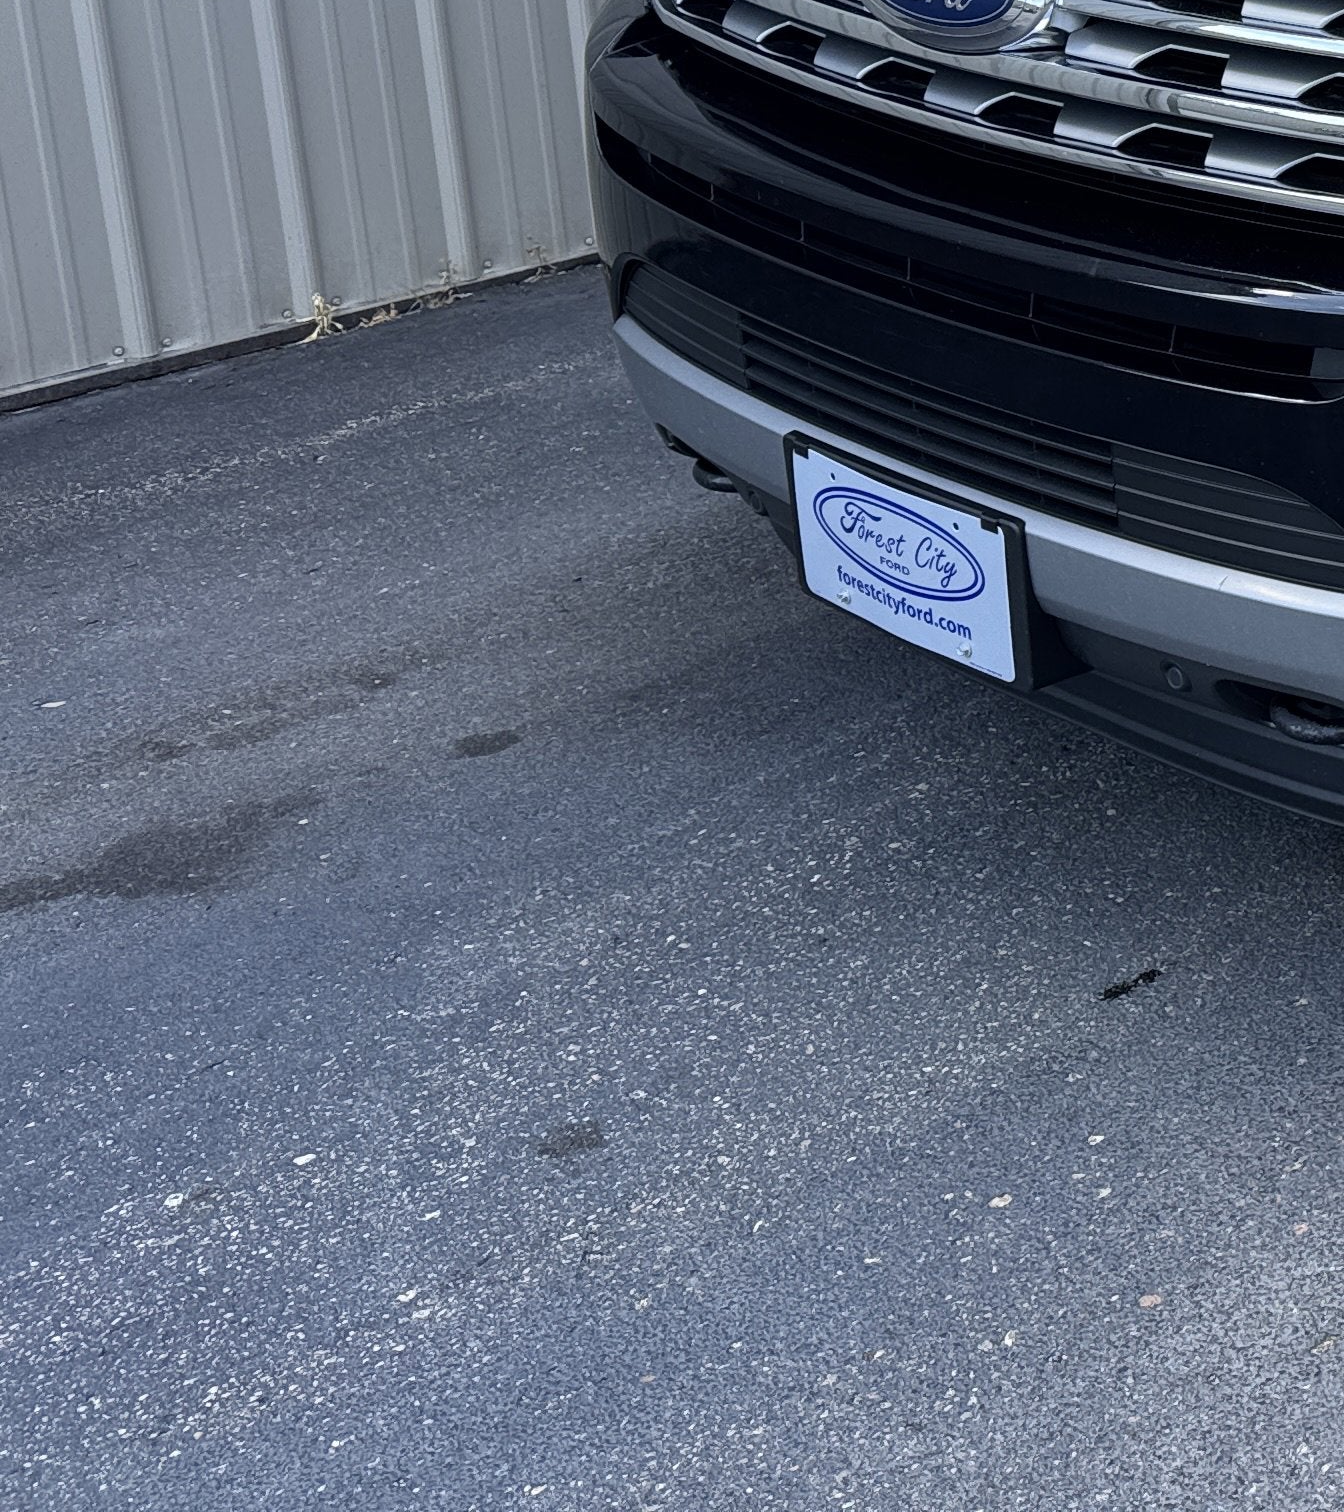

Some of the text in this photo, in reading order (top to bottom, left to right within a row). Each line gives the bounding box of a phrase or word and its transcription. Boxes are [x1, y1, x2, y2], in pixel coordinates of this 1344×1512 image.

[839, 501, 958, 589] Forest City
[879, 555, 911, 576] FORD
[836, 565, 973, 641] forestcityford.com
